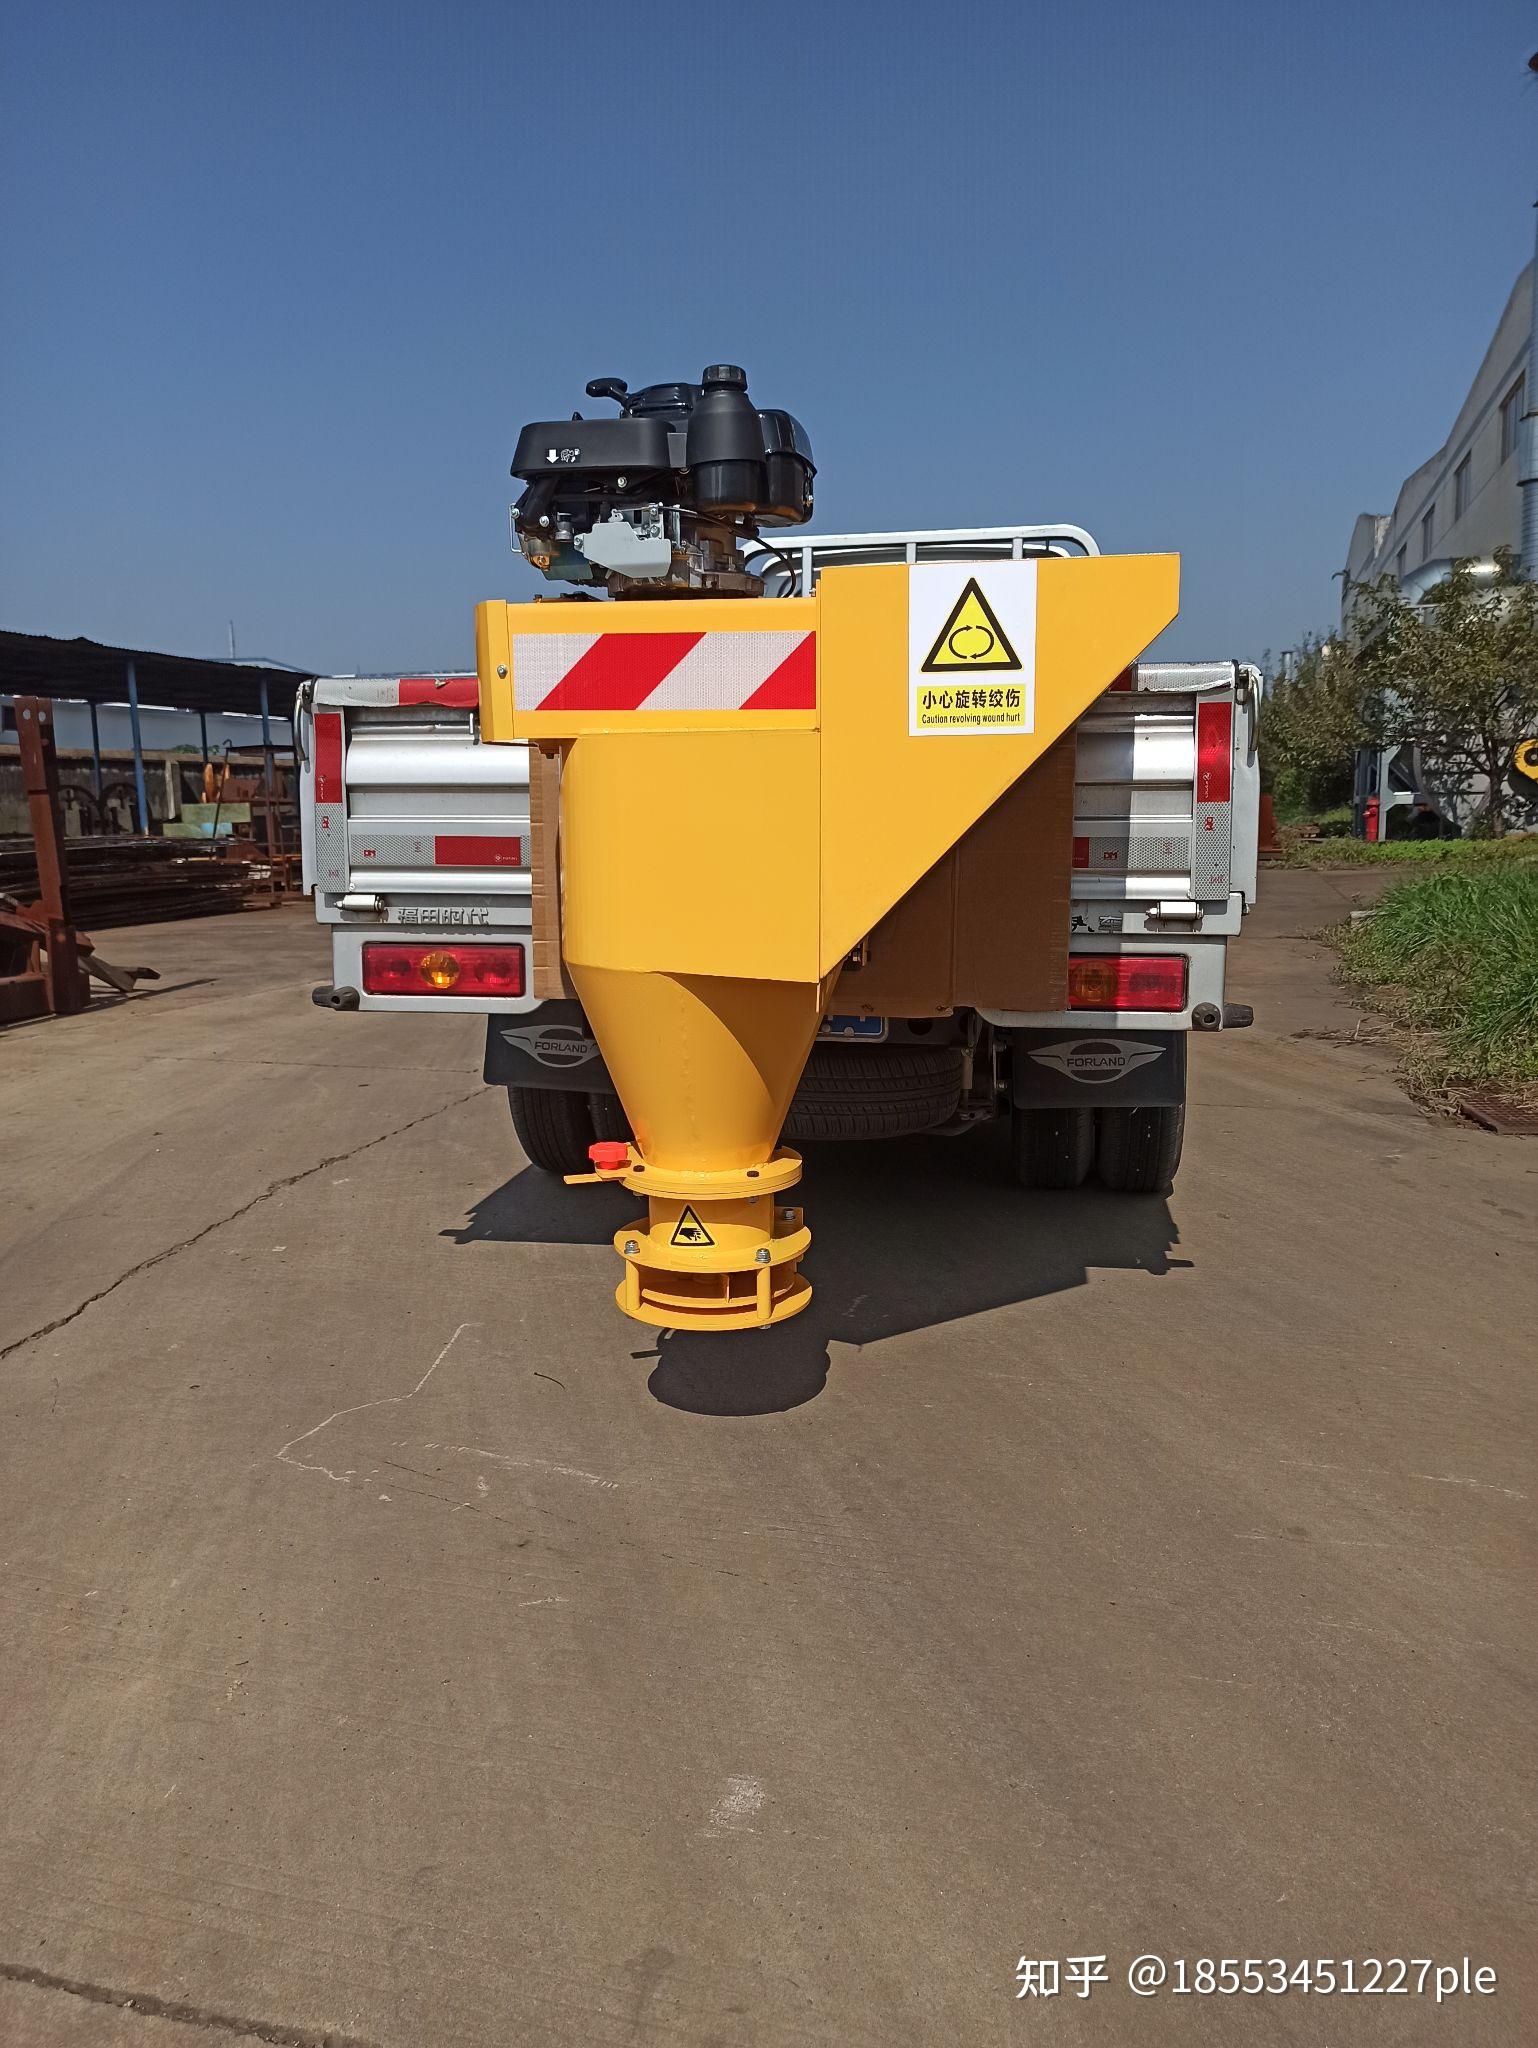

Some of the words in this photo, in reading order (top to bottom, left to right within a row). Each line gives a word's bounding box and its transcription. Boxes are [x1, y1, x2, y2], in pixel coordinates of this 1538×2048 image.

[922, 688, 1021, 710] 小心旋转绞伤
[921, 713, 948, 724] Caution
[949, 713, 981, 726] revolving
[982, 713, 1005, 723] wound
[1006, 712, 1021, 722] hurt
[398, 907, 490, 926] 福田时代
[534, 1041, 588, 1054] FORLAND
[1066, 1057, 1126, 1068] FORLAND
